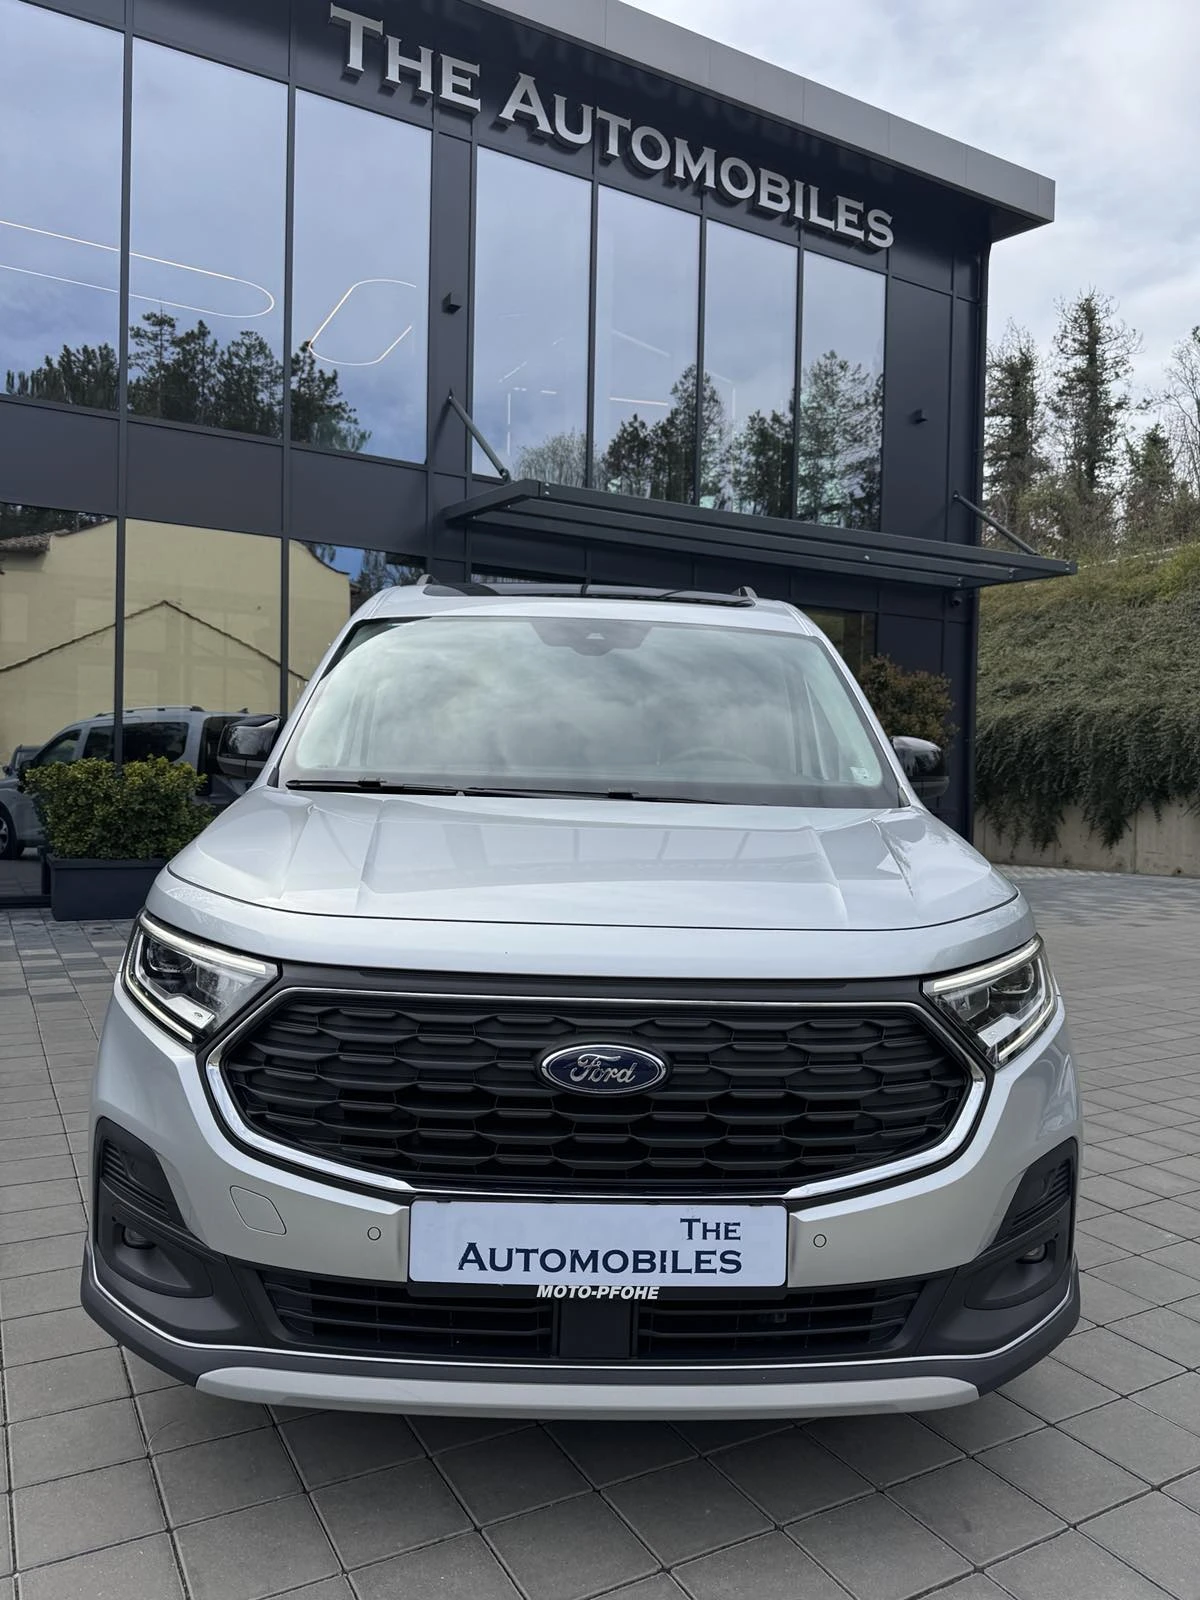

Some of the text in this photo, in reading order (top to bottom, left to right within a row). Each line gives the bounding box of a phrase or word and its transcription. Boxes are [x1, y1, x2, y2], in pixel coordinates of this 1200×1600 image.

[330, 3, 894, 249] THE AUTOMOBILES
[570, 1053, 637, 1083] Ford
[680, 1217, 741, 1240] THE
[457, 1241, 742, 1274] AUTOMOBILES
[536, 1285, 660, 1300] MOTO-PFOHE
